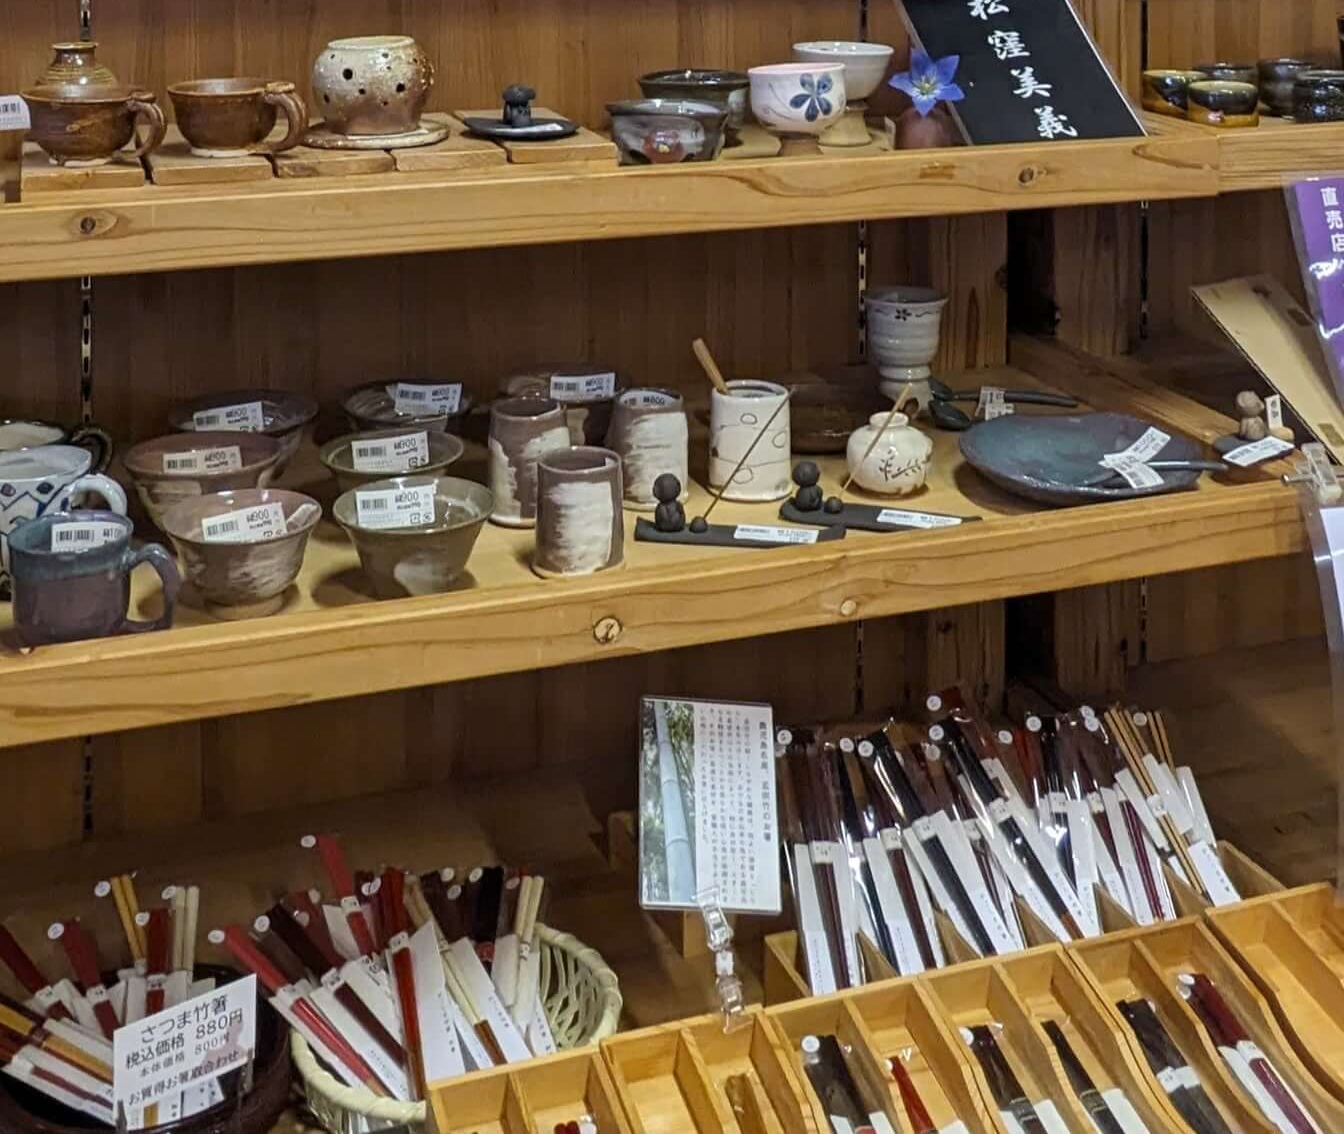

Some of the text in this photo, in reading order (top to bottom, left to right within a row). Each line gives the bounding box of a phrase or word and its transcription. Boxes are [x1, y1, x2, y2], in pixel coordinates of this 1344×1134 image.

[126, 1007, 243, 1069] 税込価格 880円
[141, 993, 228, 1043] さつま竹箸
[140, 1053, 185, 1076] 本体価格
